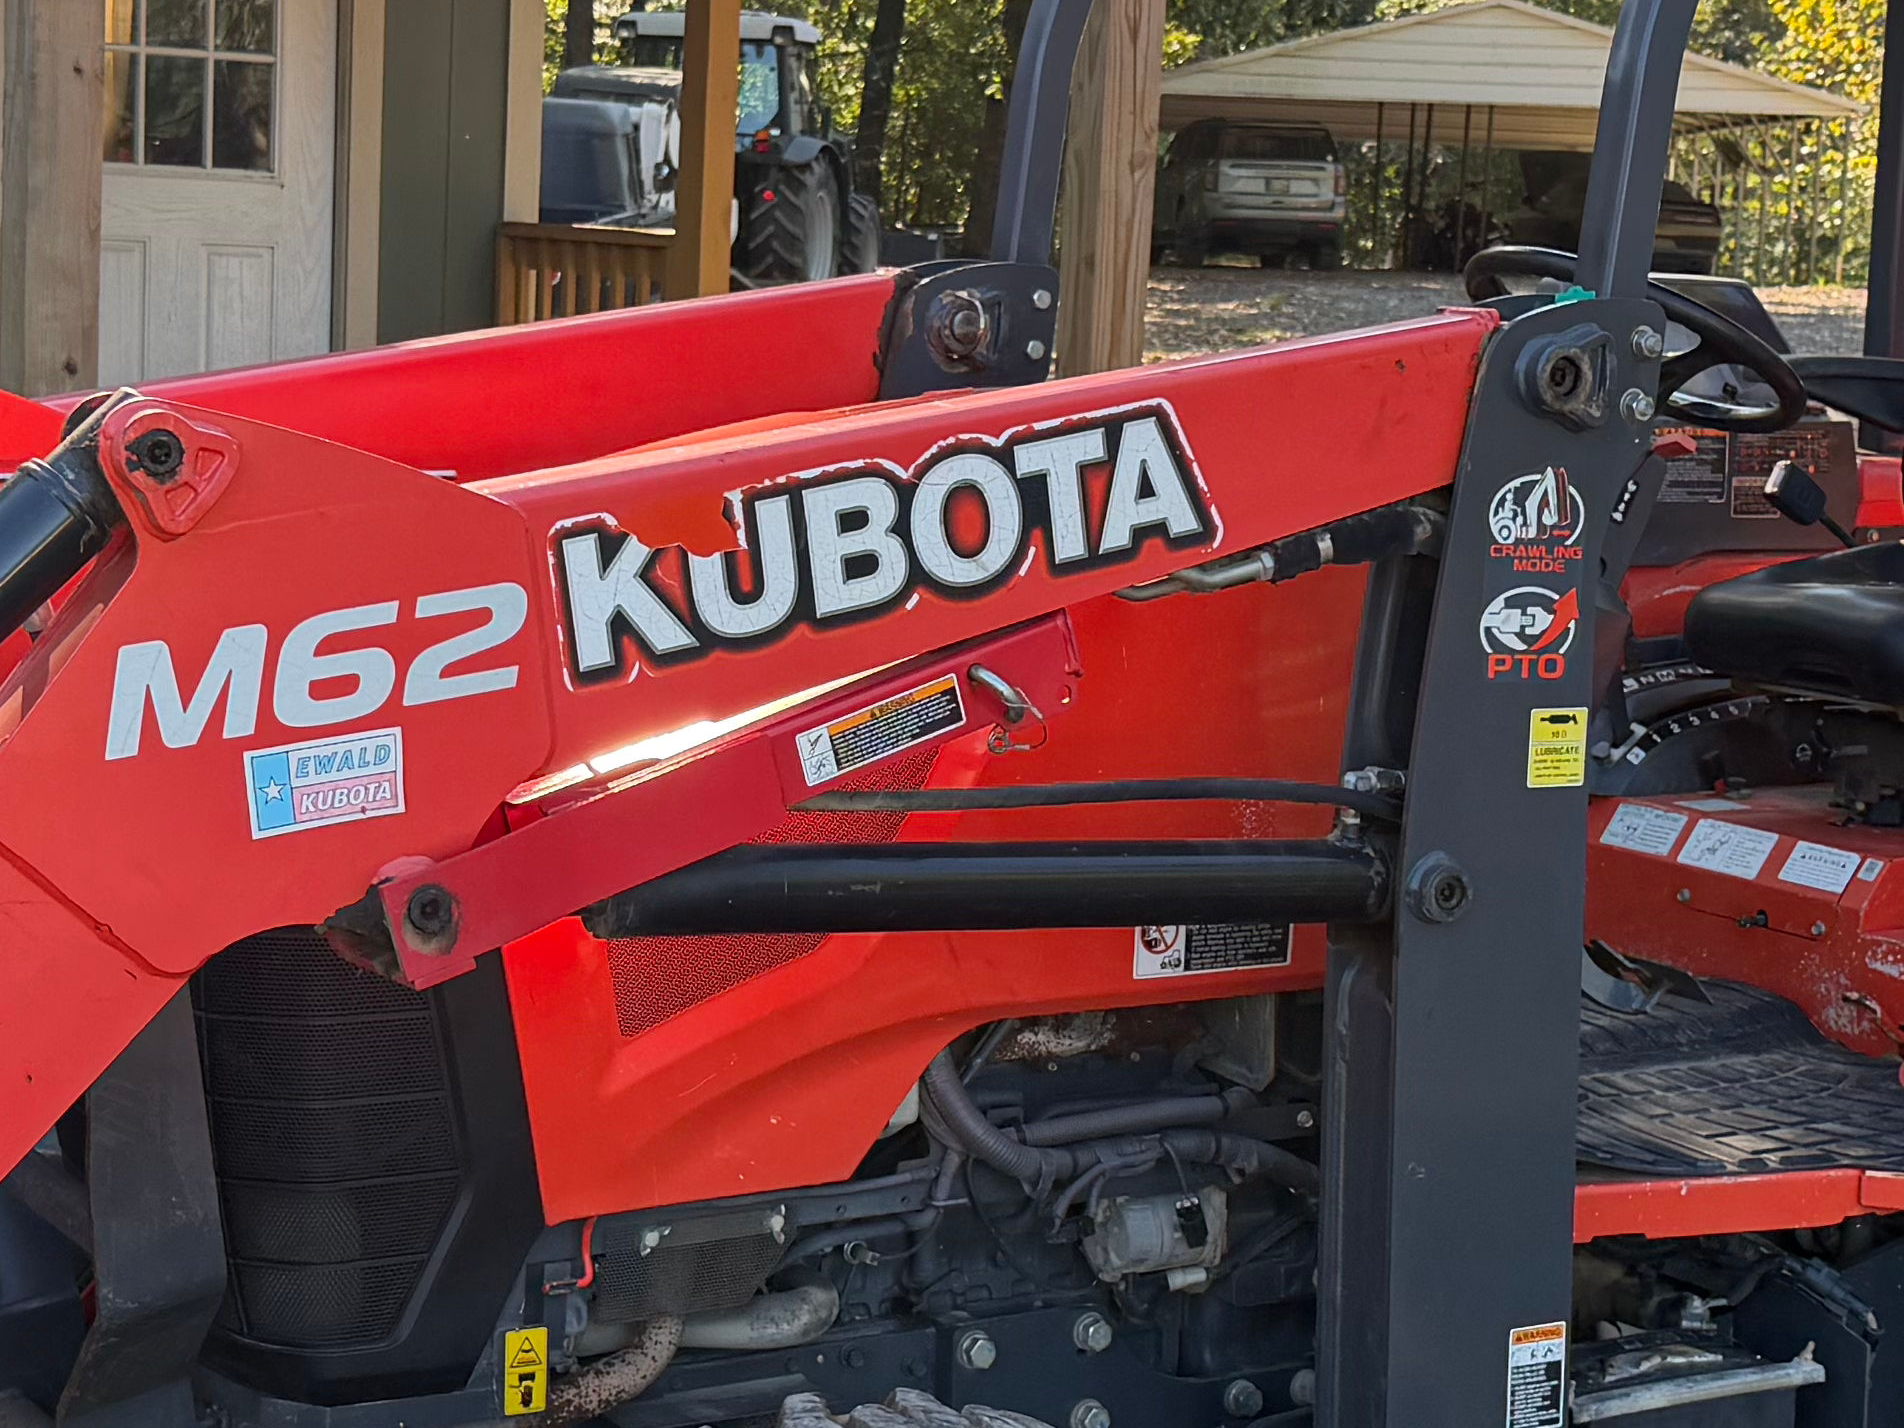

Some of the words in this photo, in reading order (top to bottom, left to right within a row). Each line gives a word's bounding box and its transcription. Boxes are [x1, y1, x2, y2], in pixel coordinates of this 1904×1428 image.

[558, 414, 1204, 674] KUBOTA
[1489, 543, 1584, 560] CRAWLING
[1512, 559, 1567, 573] MODE
[104, 581, 531, 762] M62
[1487, 653, 1567, 681] PTO
[295, 743, 392, 779] EWALD
[1534, 746, 1580, 757] LUBRICATE
[300, 779, 392, 815] KUBOTA
